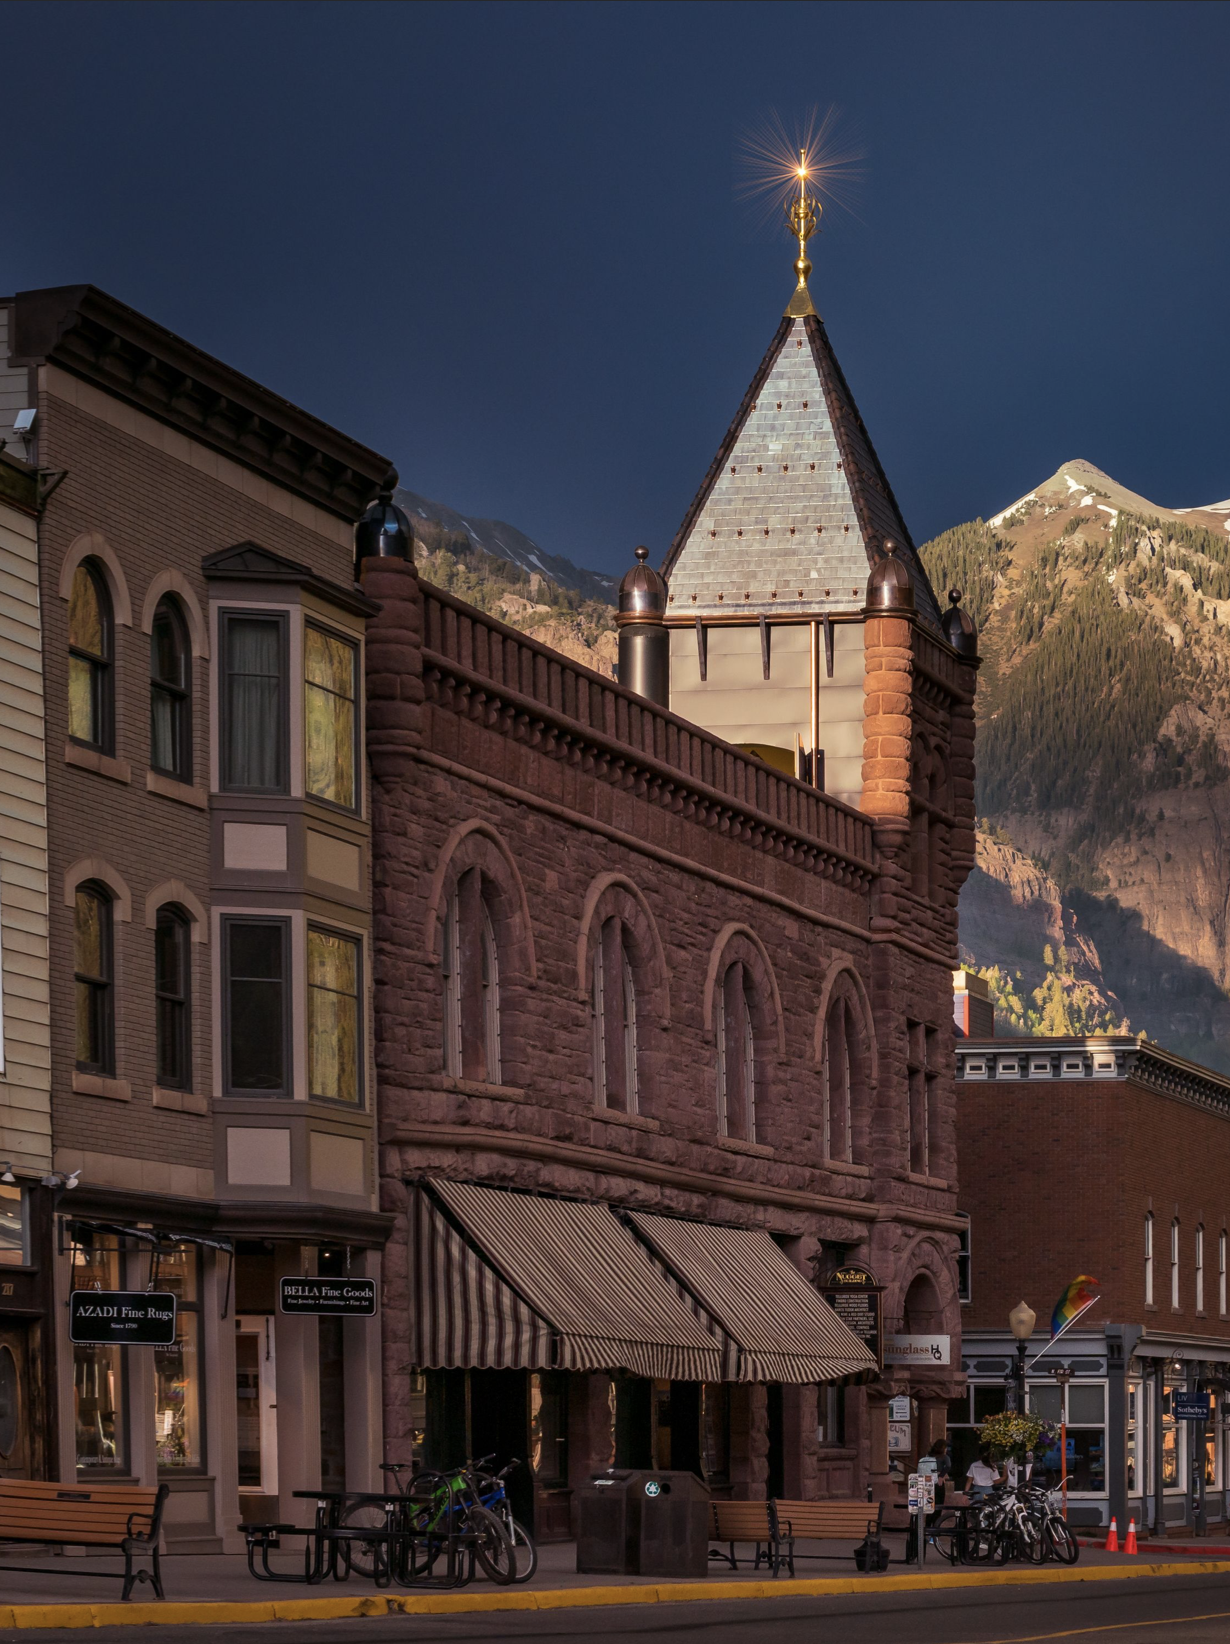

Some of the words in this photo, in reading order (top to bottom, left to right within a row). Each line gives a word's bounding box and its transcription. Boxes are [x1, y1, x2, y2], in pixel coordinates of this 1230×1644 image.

[284, 1286, 319, 1296] BELLA
[321, 1287, 341, 1297] Fine
[343, 1287, 373, 1298] Goods
[76, 1306, 118, 1317] AZADI
[121, 1307, 145, 1318] Fine
[147, 1307, 174, 1321] Rugs
[884, 1343, 930, 1356] sunglass
[931, 1344, 942, 1361] HQ
[1177, 1406, 1207, 1415] Sotheby's
